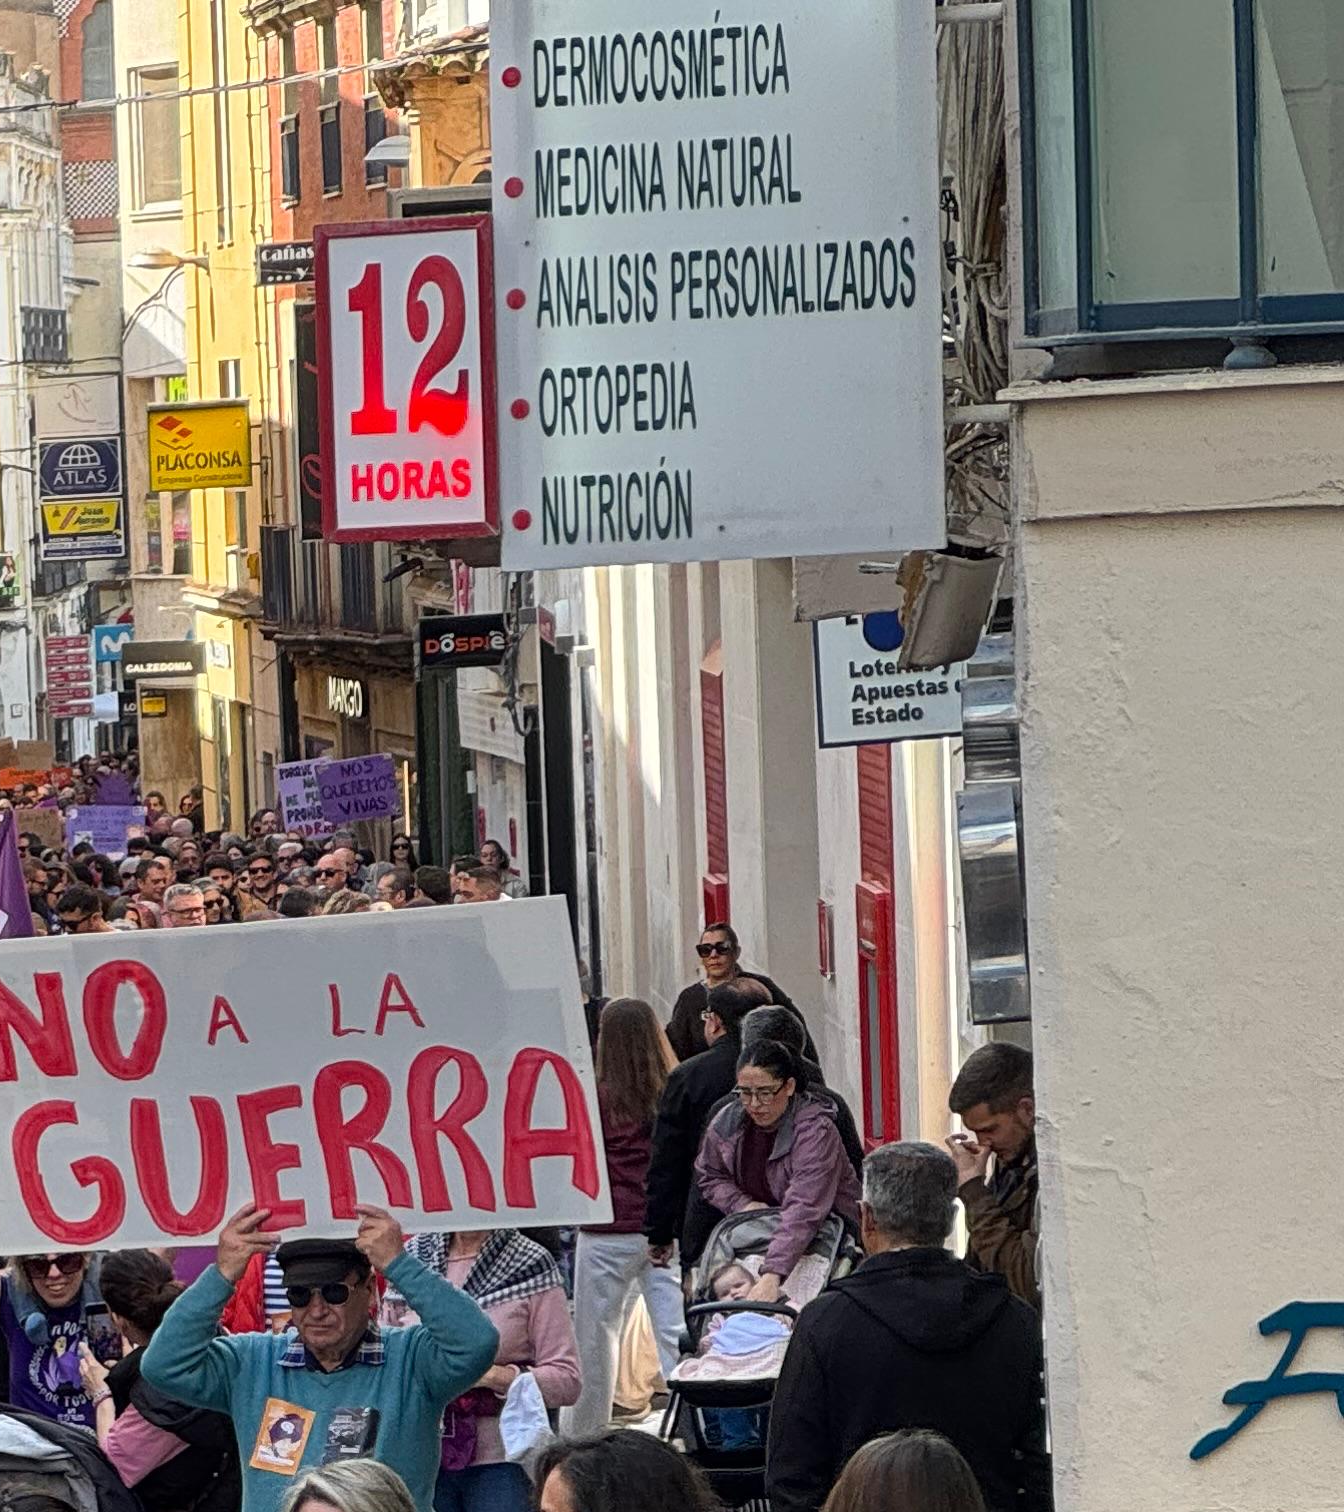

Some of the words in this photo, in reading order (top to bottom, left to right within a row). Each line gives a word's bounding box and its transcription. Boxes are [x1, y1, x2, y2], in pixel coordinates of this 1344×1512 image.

[532, 10, 790, 109] DERMOCOSMÉTICA
[534, 141, 667, 219] MEDICINA
[677, 133, 802, 211] NATURAL
[536, 251, 659, 329] ANALISIS
[670, 236, 916, 322] PERSONALIZADOS
[347, 255, 471, 438] 12
[538, 360, 698, 438] ORTOPEDIA
[53, 468, 108, 486] ATLAS
[156, 450, 243, 472] PLACONSA
[351, 458, 472, 502] HORAS
[541, 456, 694, 546] NUTRICIÓN
[328, 675, 363, 718] MANGO
[851, 679, 949, 705] Apuestas
[851, 703, 924, 726] Estado
[208, 994, 249, 1046] A
[328, 972, 426, 1037] LA
[12, 1045, 600, 1246] GUERRA
